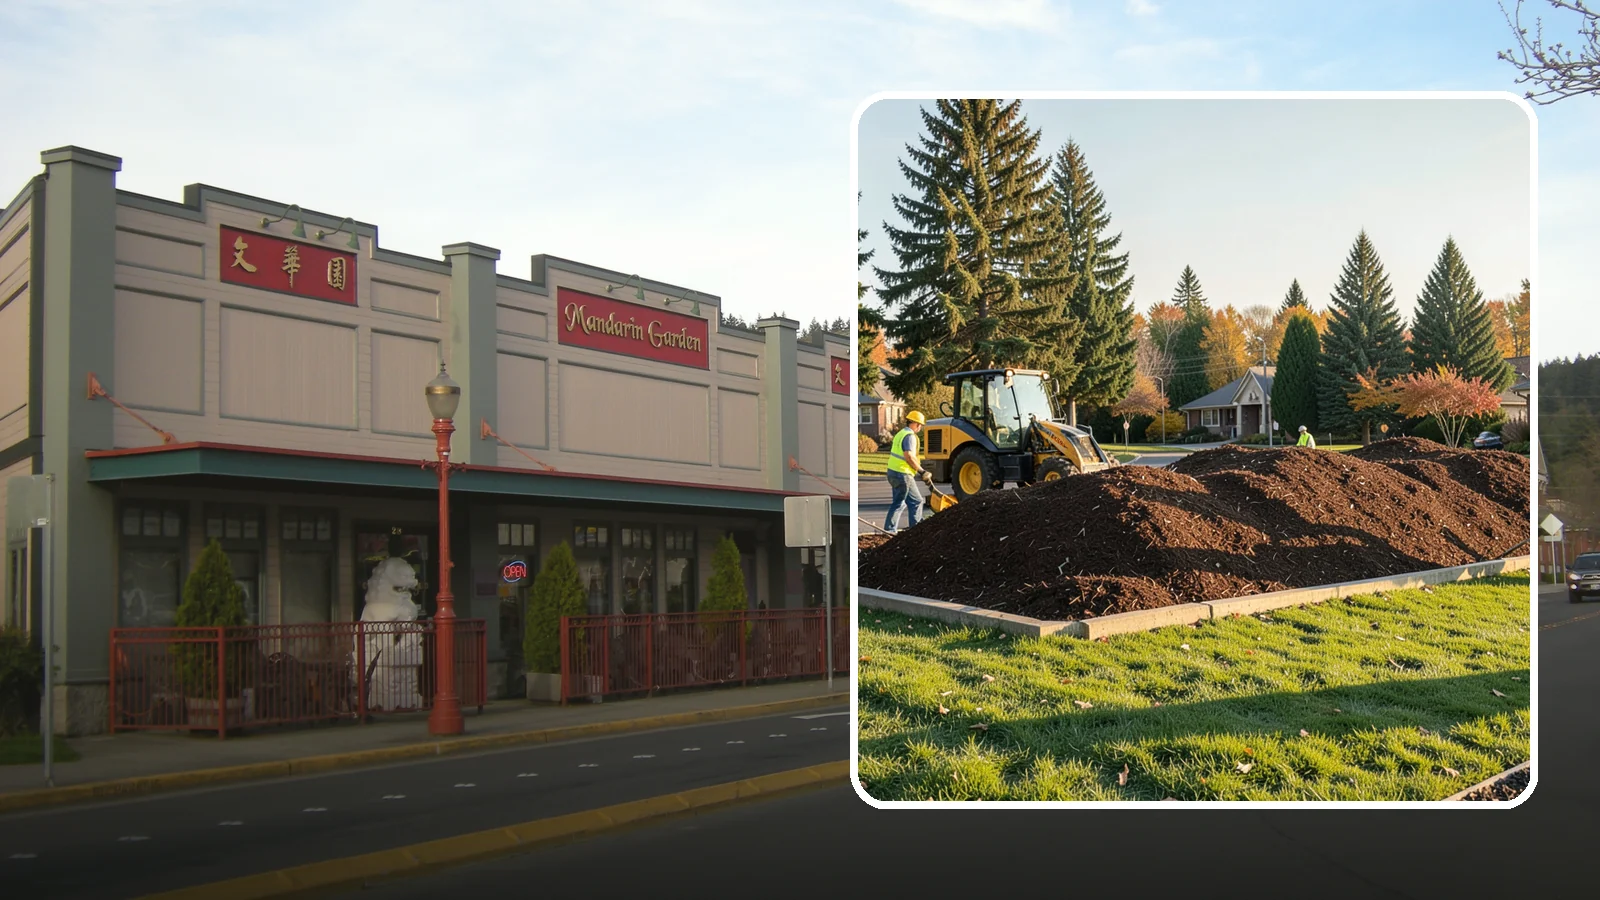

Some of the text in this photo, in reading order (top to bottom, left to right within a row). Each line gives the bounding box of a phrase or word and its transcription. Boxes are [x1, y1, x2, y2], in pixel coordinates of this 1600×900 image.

[564, 302, 701, 352] Mandarin Garden
[503, 565, 527, 578] OPEN
